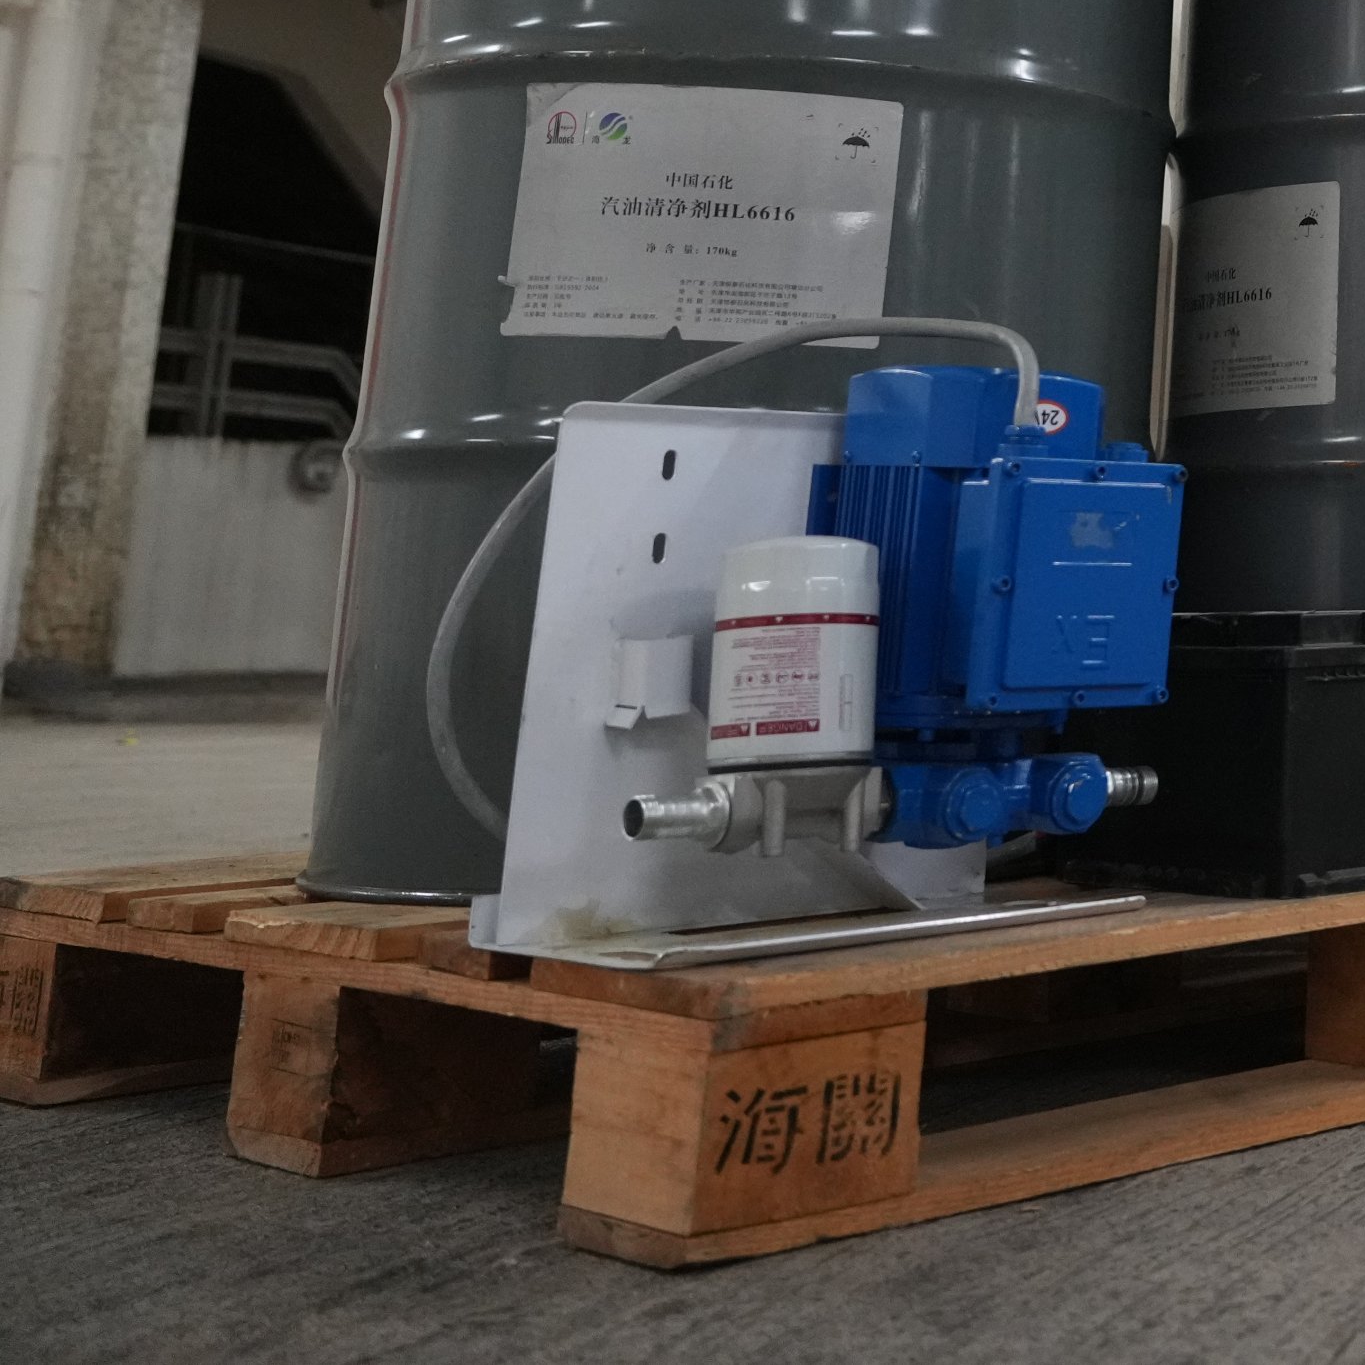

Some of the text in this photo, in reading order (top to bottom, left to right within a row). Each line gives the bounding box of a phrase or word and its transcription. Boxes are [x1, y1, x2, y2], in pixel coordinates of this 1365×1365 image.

[665, 171, 735, 191] 中国石化
[600, 196, 797, 223] 汽油清净剂HL6616
[706, 245, 738, 257] 170kg
[715, 1069, 902, 1177] 海關
